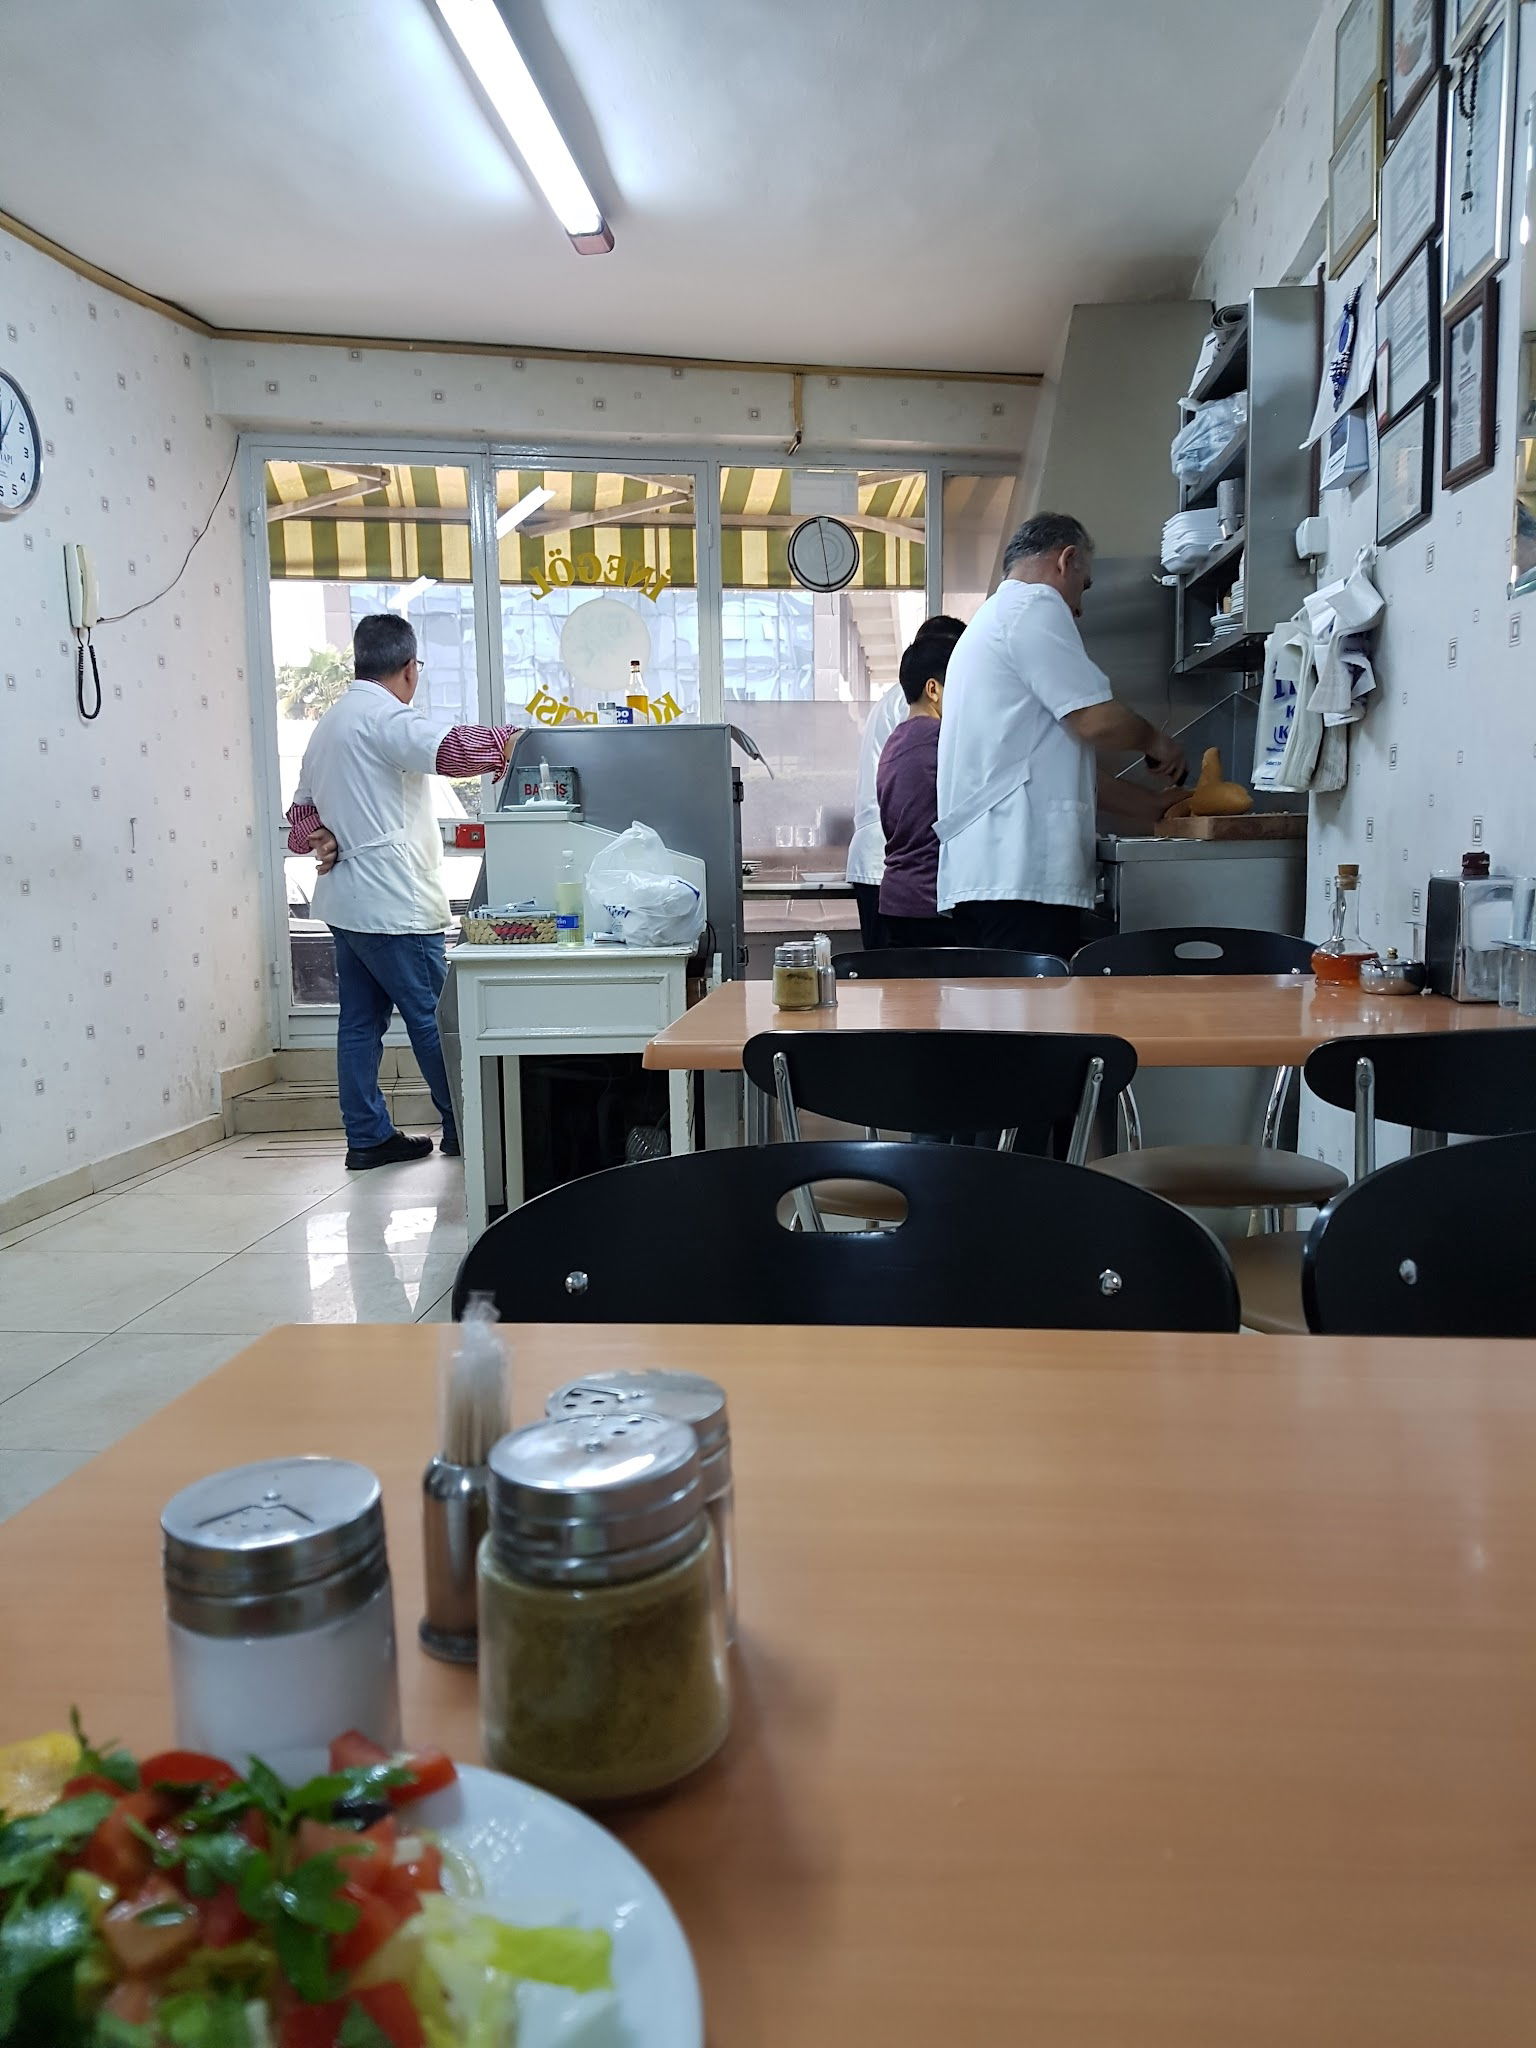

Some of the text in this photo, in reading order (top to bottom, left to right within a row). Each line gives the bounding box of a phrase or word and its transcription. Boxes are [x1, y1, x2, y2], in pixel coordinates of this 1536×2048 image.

[18, 422, 25, 434] 2
[23, 446, 29, 459] 3
[20, 472, 26, 483] 4
[11, 483, 18, 495] 5
[524, 781, 567, 797] BAİŞ
